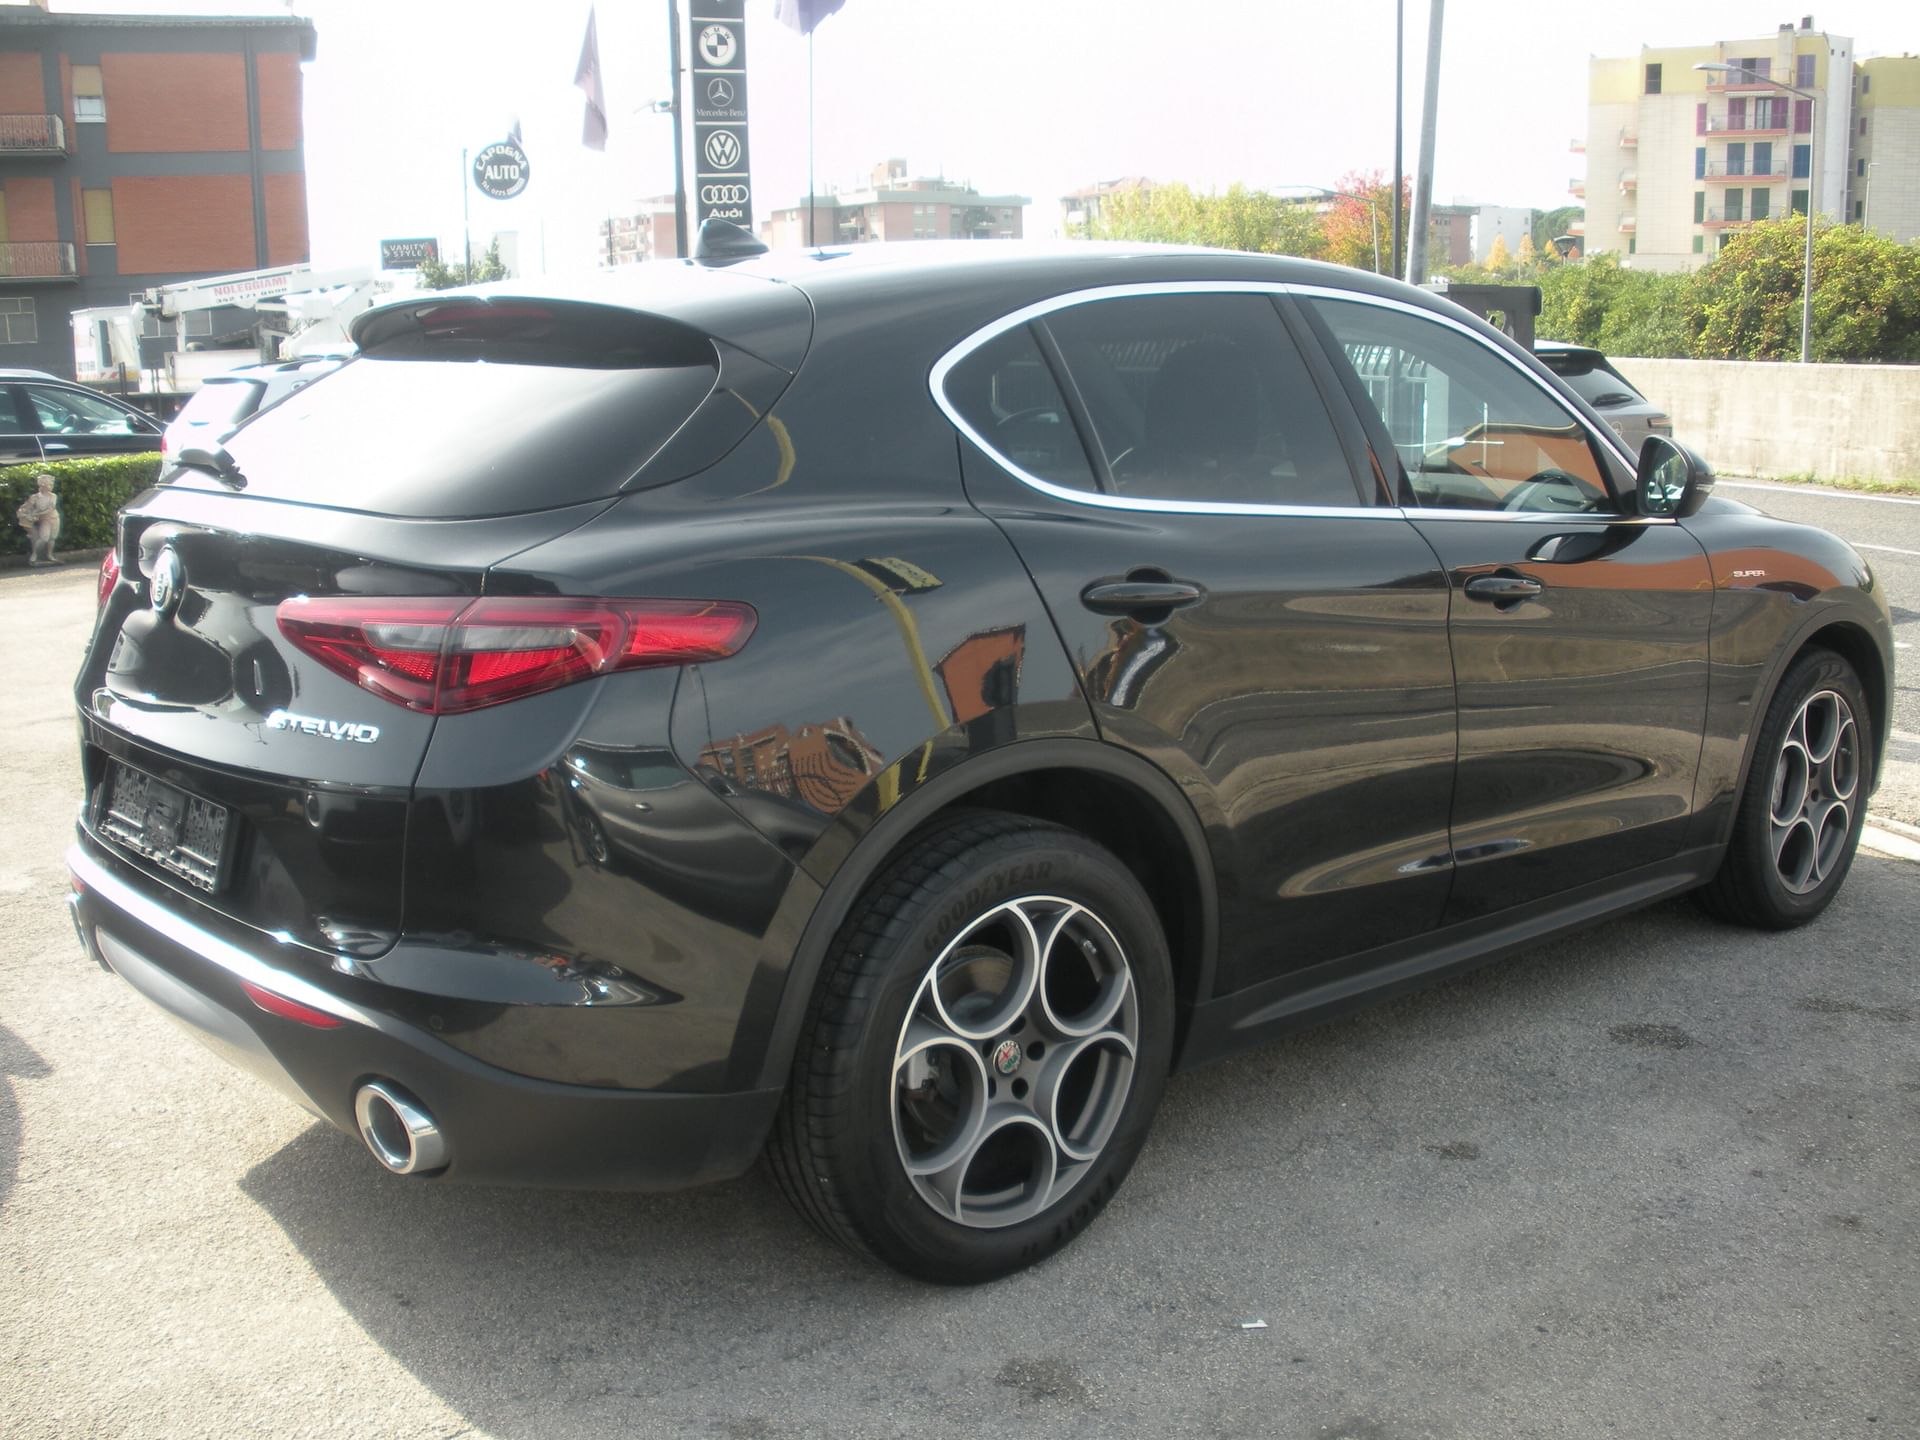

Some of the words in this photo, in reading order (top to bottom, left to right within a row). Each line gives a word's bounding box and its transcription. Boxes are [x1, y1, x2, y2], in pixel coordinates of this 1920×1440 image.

[476, 145, 527, 170] CAPOGNA
[484, 164, 519, 180] AUTO
[708, 208, 743, 218] Audi
[389, 243, 425, 251] VANITY
[213, 276, 288, 296] NOLEGGIAMI
[266, 709, 380, 743] STELVIO
